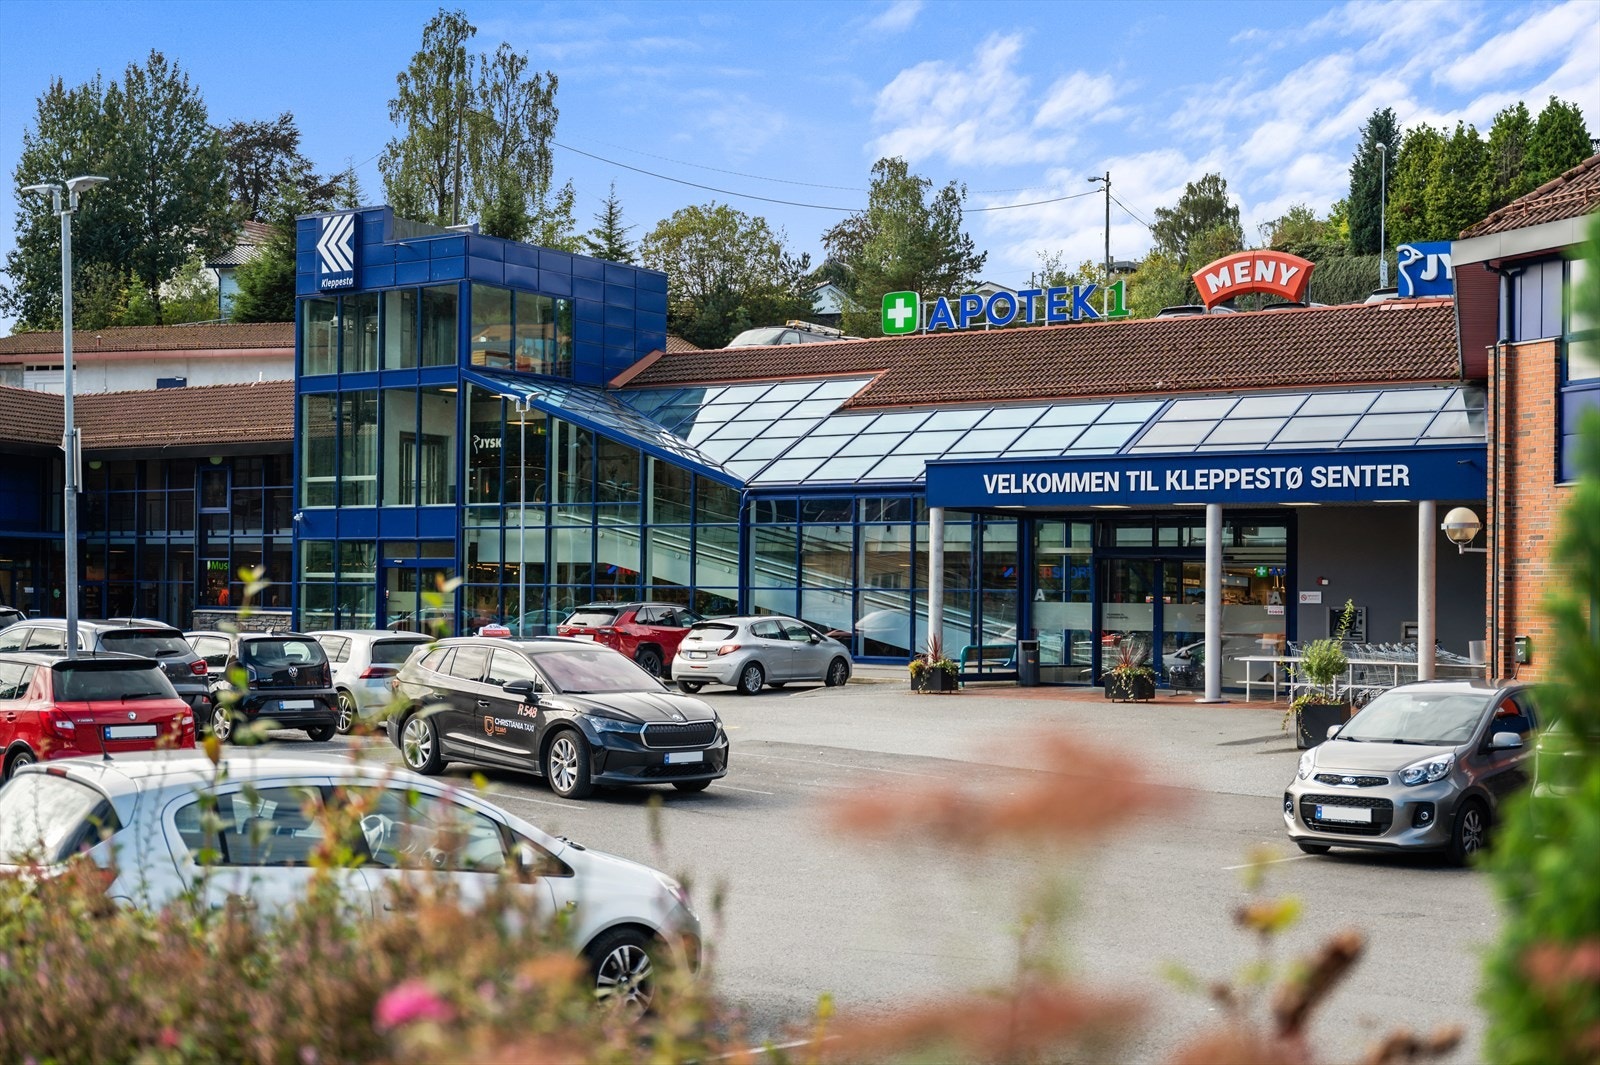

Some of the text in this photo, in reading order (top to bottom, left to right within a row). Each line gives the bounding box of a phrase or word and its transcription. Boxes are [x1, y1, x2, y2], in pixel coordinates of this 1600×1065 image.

[1205, 260, 1299, 294] MENY
[928, 280, 1132, 331] APOTEK 1
[479, 438, 502, 449] JYSK
[983, 464, 1410, 494] VELKOMMEN TIL KLEPPESTØ SENTER
[1034, 588, 1046, 601] A
[1269, 591, 1283, 605] A
[517, 703, 538, 718] R 548
[494, 717, 523, 730] CHRISTIANIA
